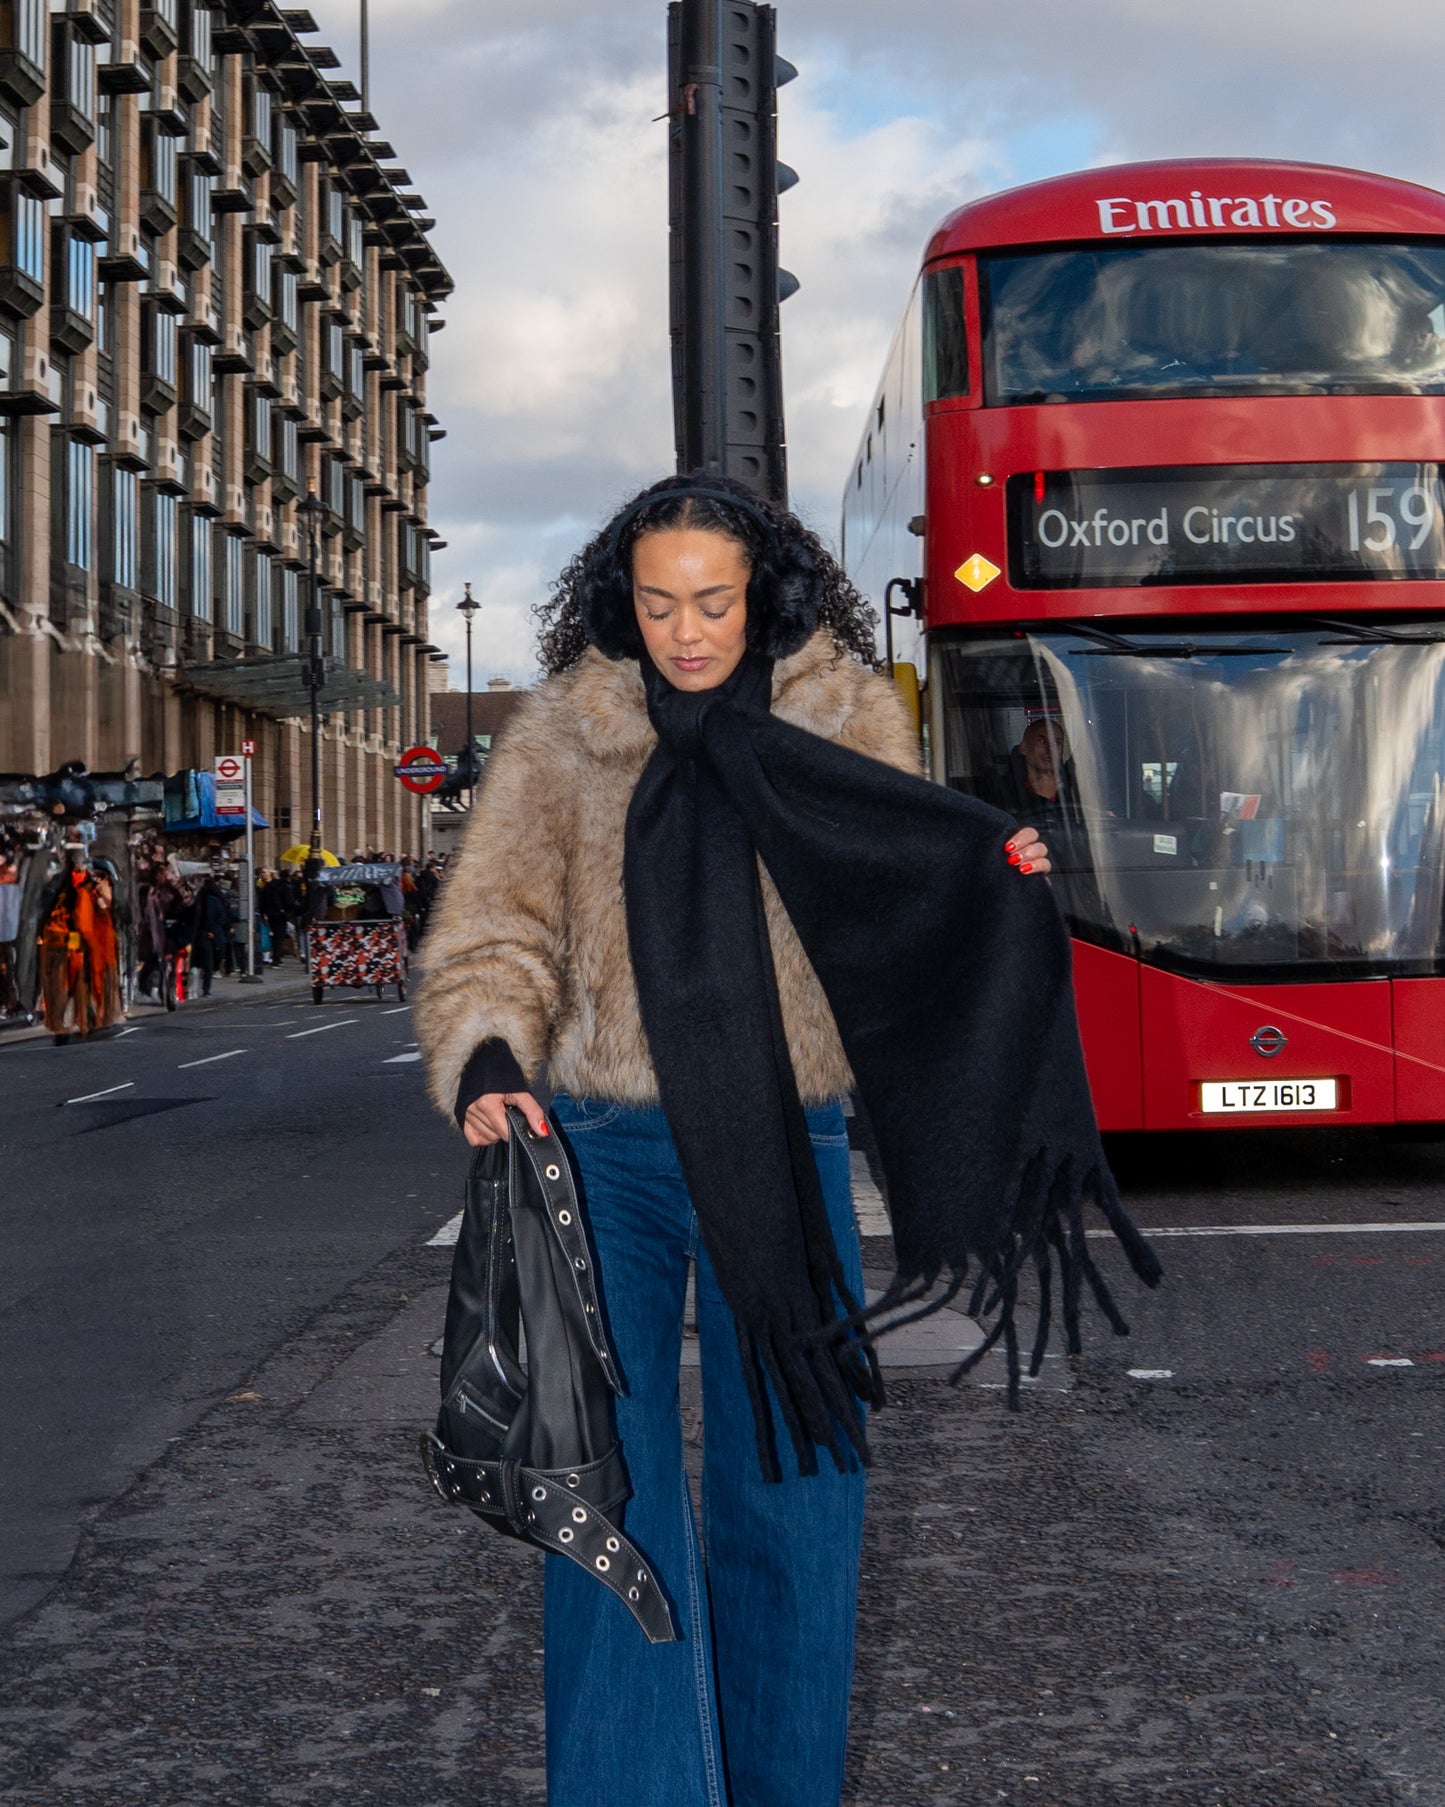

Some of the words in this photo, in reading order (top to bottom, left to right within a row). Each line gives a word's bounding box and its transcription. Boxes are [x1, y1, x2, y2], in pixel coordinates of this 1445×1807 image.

[1095, 190, 1337, 233] Emirates
[1038, 507, 1169, 548] Oxford
[1183, 505, 1296, 544] Circus
[1347, 486, 1434, 552] 159
[241, 741, 254, 754] H
[395, 766, 447, 774] UNDERGROUND
[1222, 1086, 1266, 1107] LTZ
[1274, 1085, 1315, 1106] 1613
